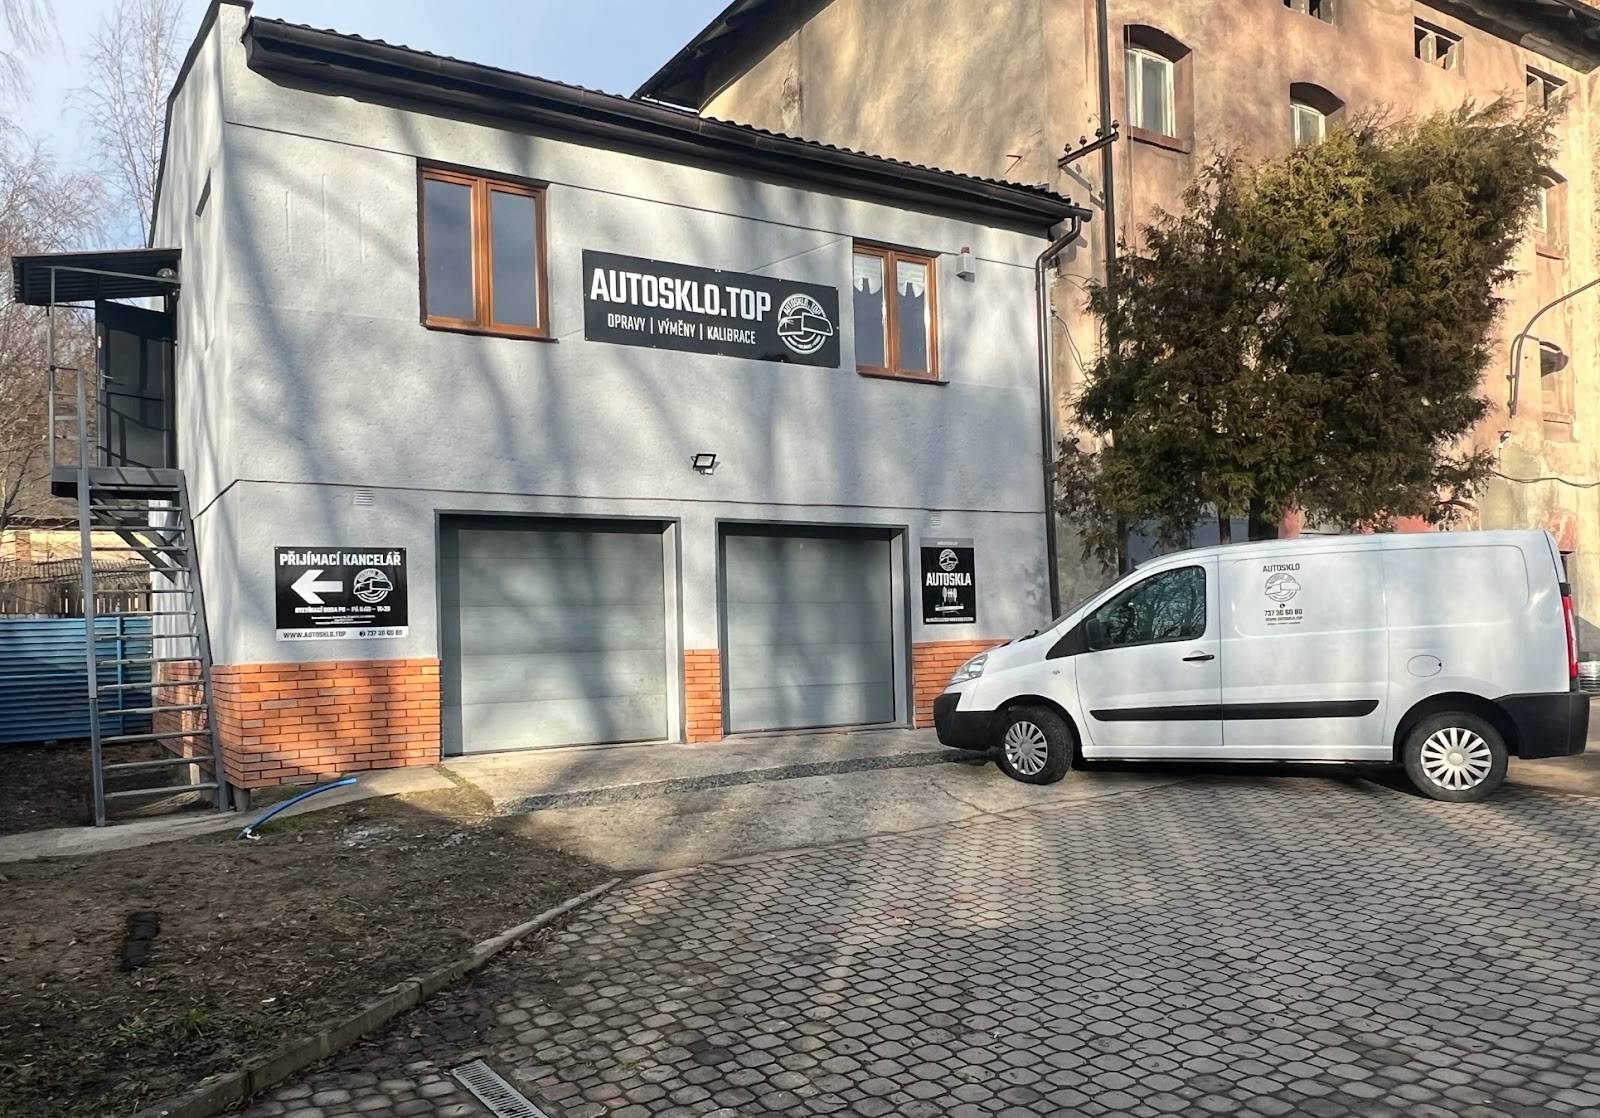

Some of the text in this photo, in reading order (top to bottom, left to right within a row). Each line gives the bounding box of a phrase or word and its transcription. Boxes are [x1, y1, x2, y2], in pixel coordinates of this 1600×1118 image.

[590, 268, 771, 322] AUTOSKLO.TOP
[607, 313, 756, 345] OPRAVY VÝMĚNY KALIBRACE
[279, 551, 401, 566] PŘIJÍMACÍ KANCELÁŘ
[1263, 563, 1300, 572] AUTOSKLO
[926, 572, 972, 586] AUTOSKLA
